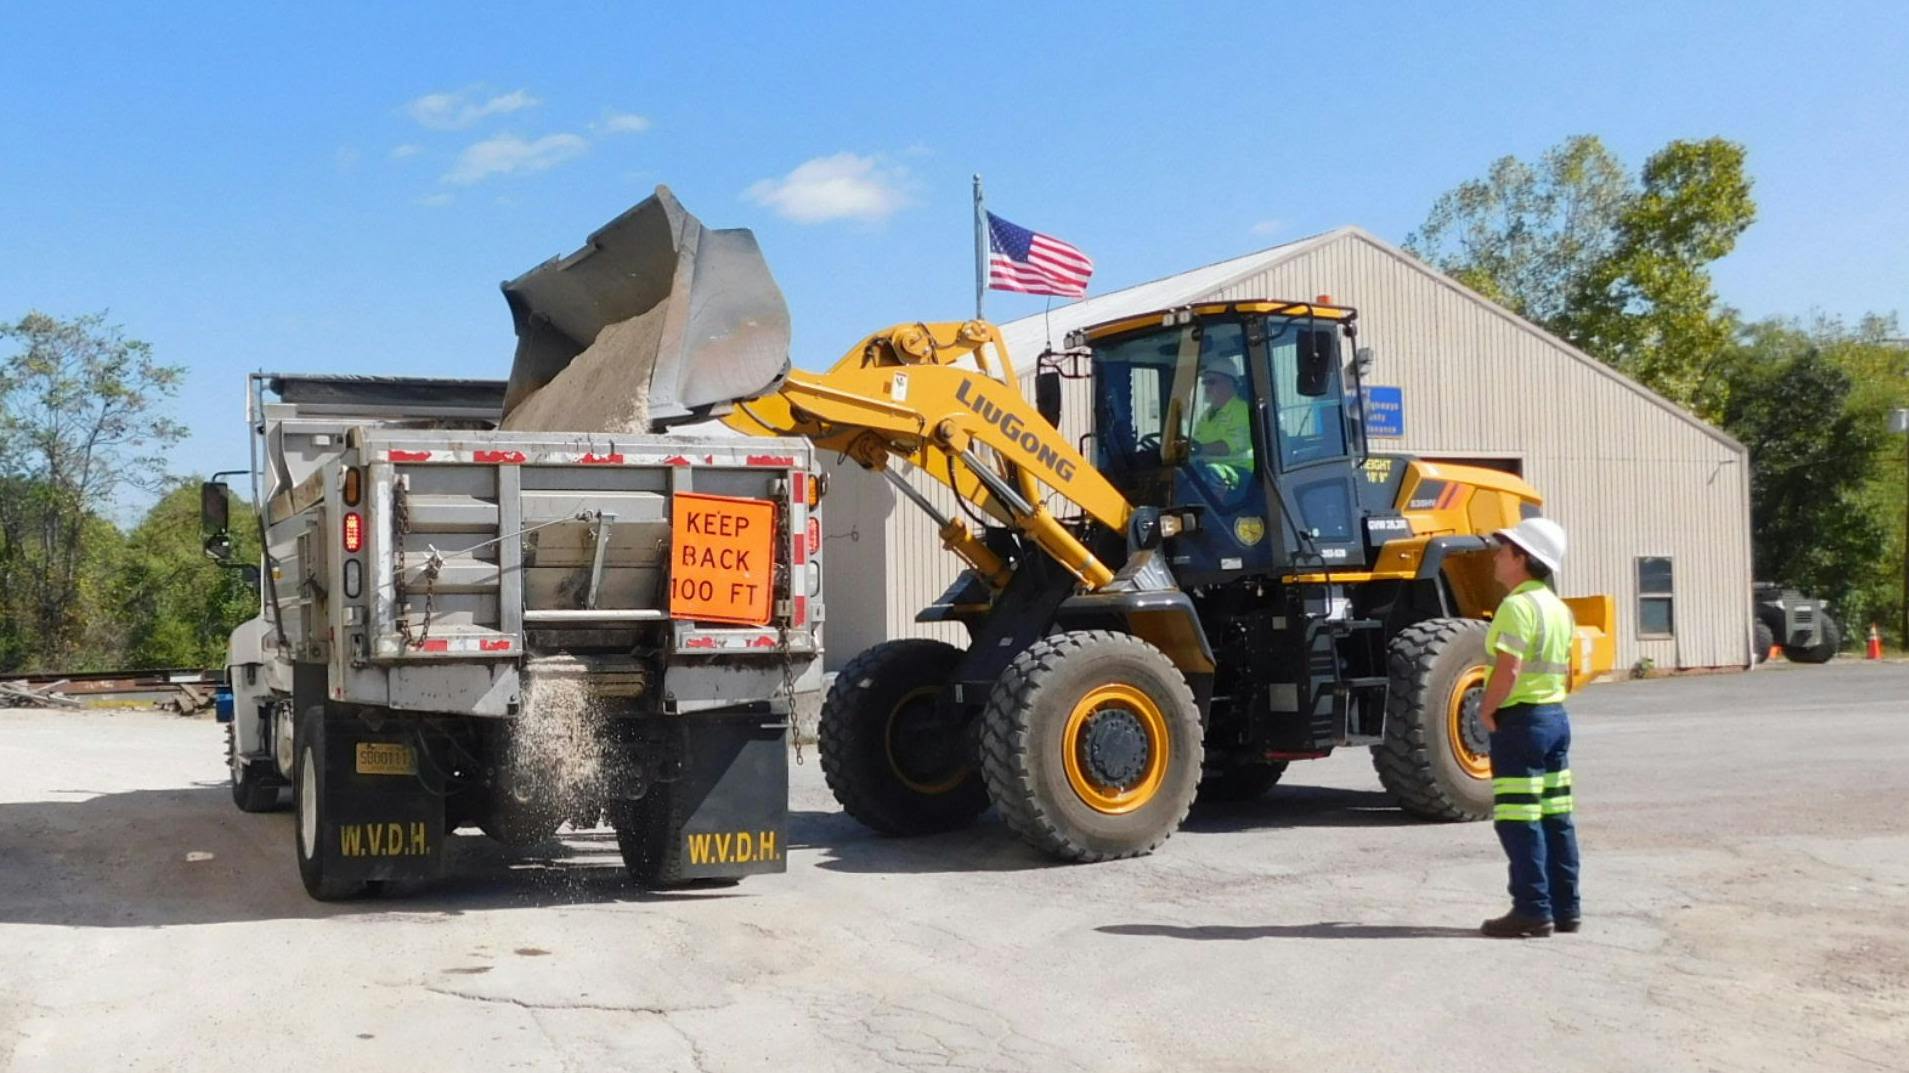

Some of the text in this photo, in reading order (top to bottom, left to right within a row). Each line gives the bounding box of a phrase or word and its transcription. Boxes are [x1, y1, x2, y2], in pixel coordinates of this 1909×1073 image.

[687, 511, 749, 537] KEEP
[682, 545, 750, 571] BACK
[672, 578, 758, 605] 100 FT
[341, 822, 431, 857] W.V.D.H.
[688, 831, 780, 865] W.V.D.H.
